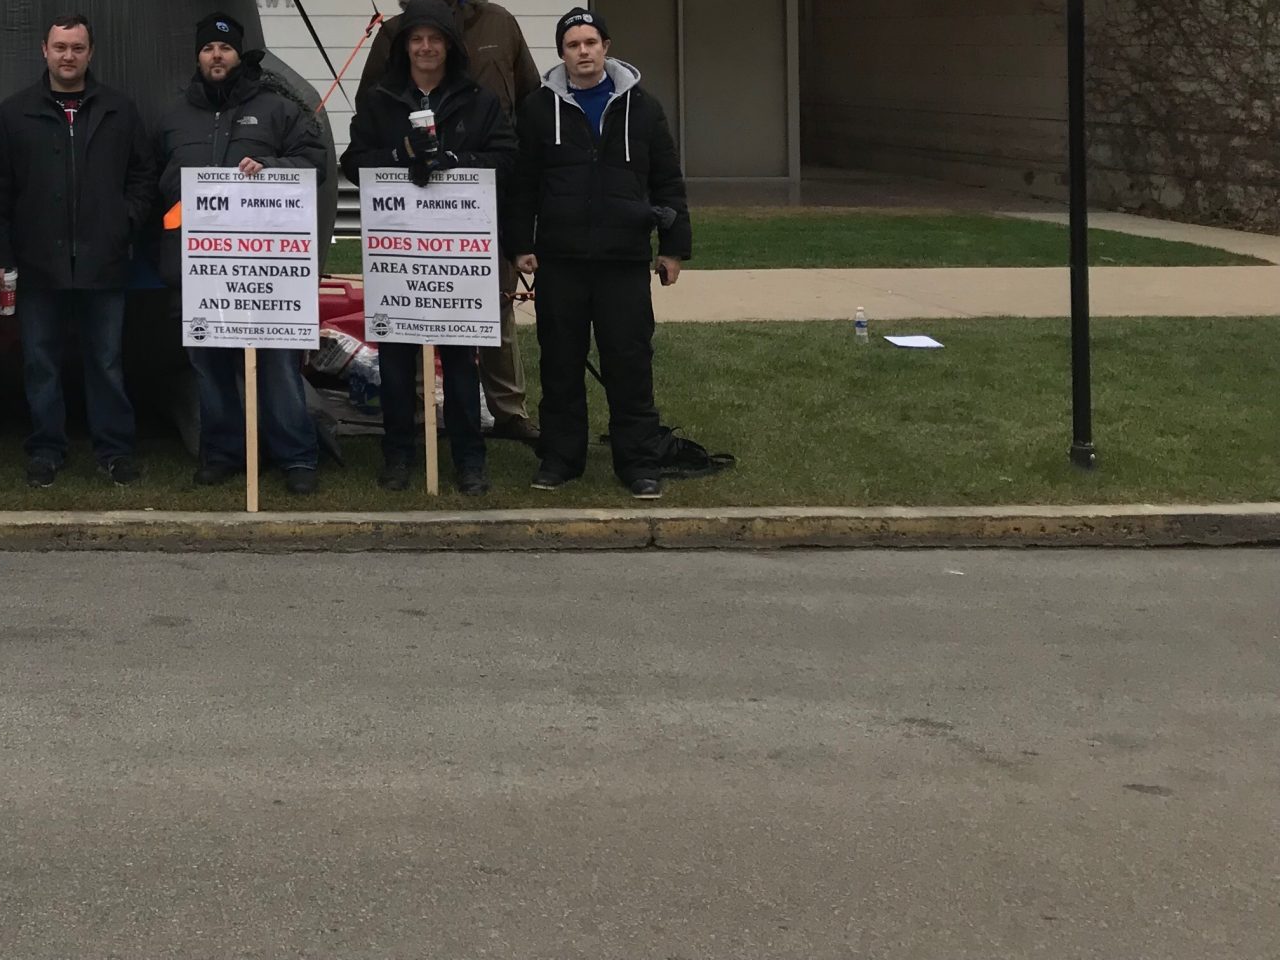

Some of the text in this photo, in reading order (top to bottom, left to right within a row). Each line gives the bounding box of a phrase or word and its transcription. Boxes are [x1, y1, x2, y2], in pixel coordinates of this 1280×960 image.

[233, 173, 245, 181] TO
[197, 196, 303, 211] MCM PARKING INC.
[373, 197, 480, 211] MCM PARKING INC.
[188, 237, 311, 253] DOES NOT PAY
[368, 236, 491, 252] DOES NOT PAY
[189, 264, 310, 277] AREA STANDARD
[370, 262, 491, 276] AREA STANDARD
[226, 282, 273, 294] WAGES
[406, 280, 454, 292] WAGES
[199, 299, 301, 311] AND BENEFITS
[380, 295, 482, 309] AND BENEFITS
[214, 326, 264, 335] TEAMSTERS
[298, 328, 311, 336] 727
[396, 323, 493, 333] TEAMSTERS LOCAL 727
